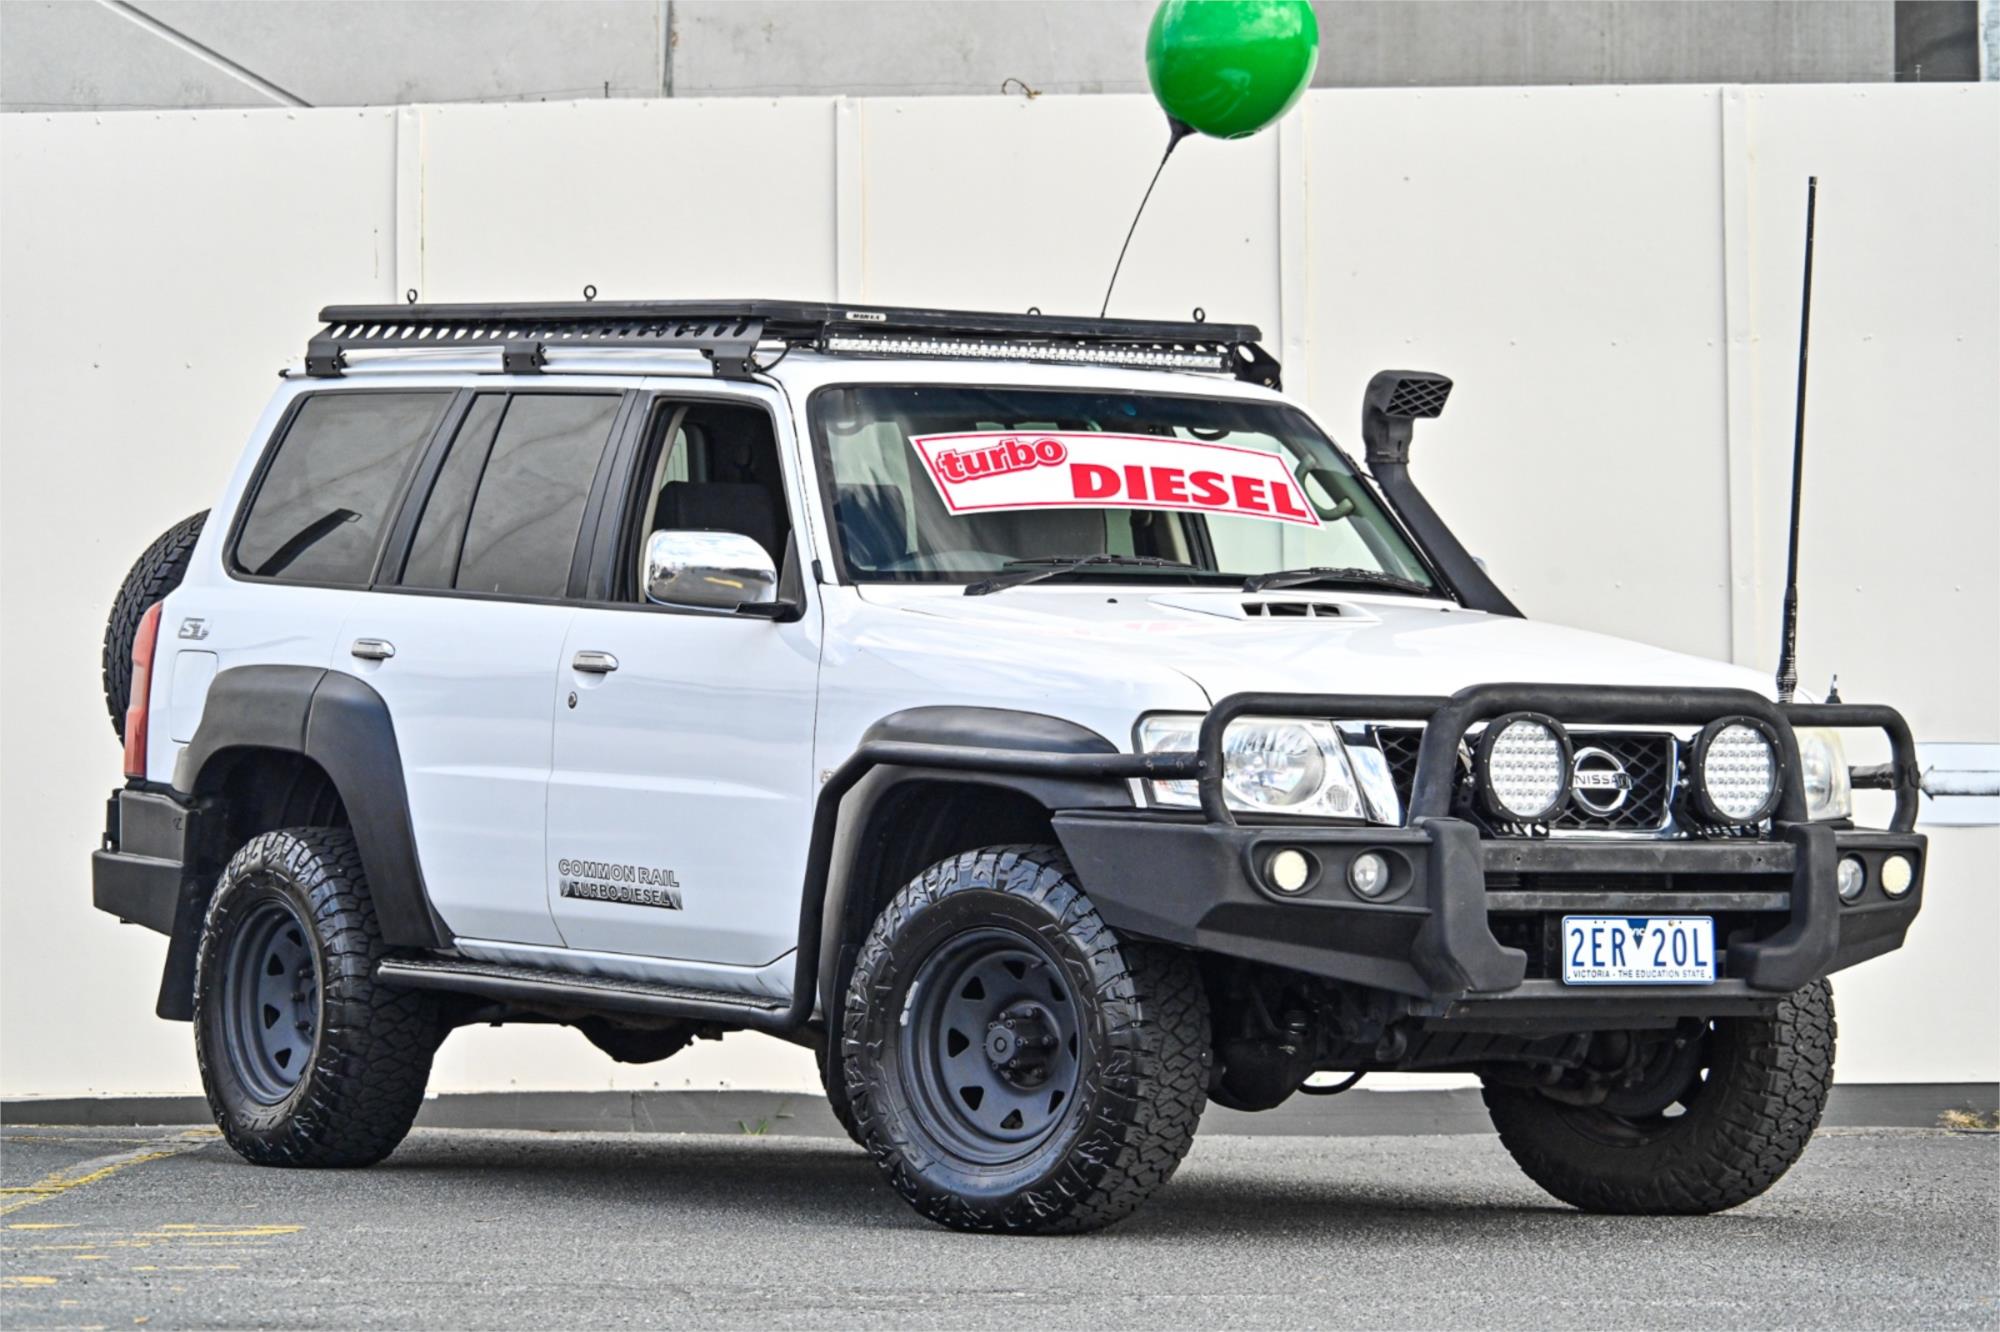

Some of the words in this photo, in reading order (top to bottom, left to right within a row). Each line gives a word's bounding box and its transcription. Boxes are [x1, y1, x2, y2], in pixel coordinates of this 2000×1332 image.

[937, 438, 1066, 484] turbo
[1070, 463, 1308, 518] DIESEL
[559, 859, 635, 883] COMMON
[638, 867, 680, 888] RAIL
[1570, 927, 1626, 967] 2ER
[1573, 969, 1610, 978] VICTORIA
[1618, 969, 1633, 978] THE
[1635, 969, 1680, 978] EDUCATION
[1682, 969, 1705, 978] STATE
